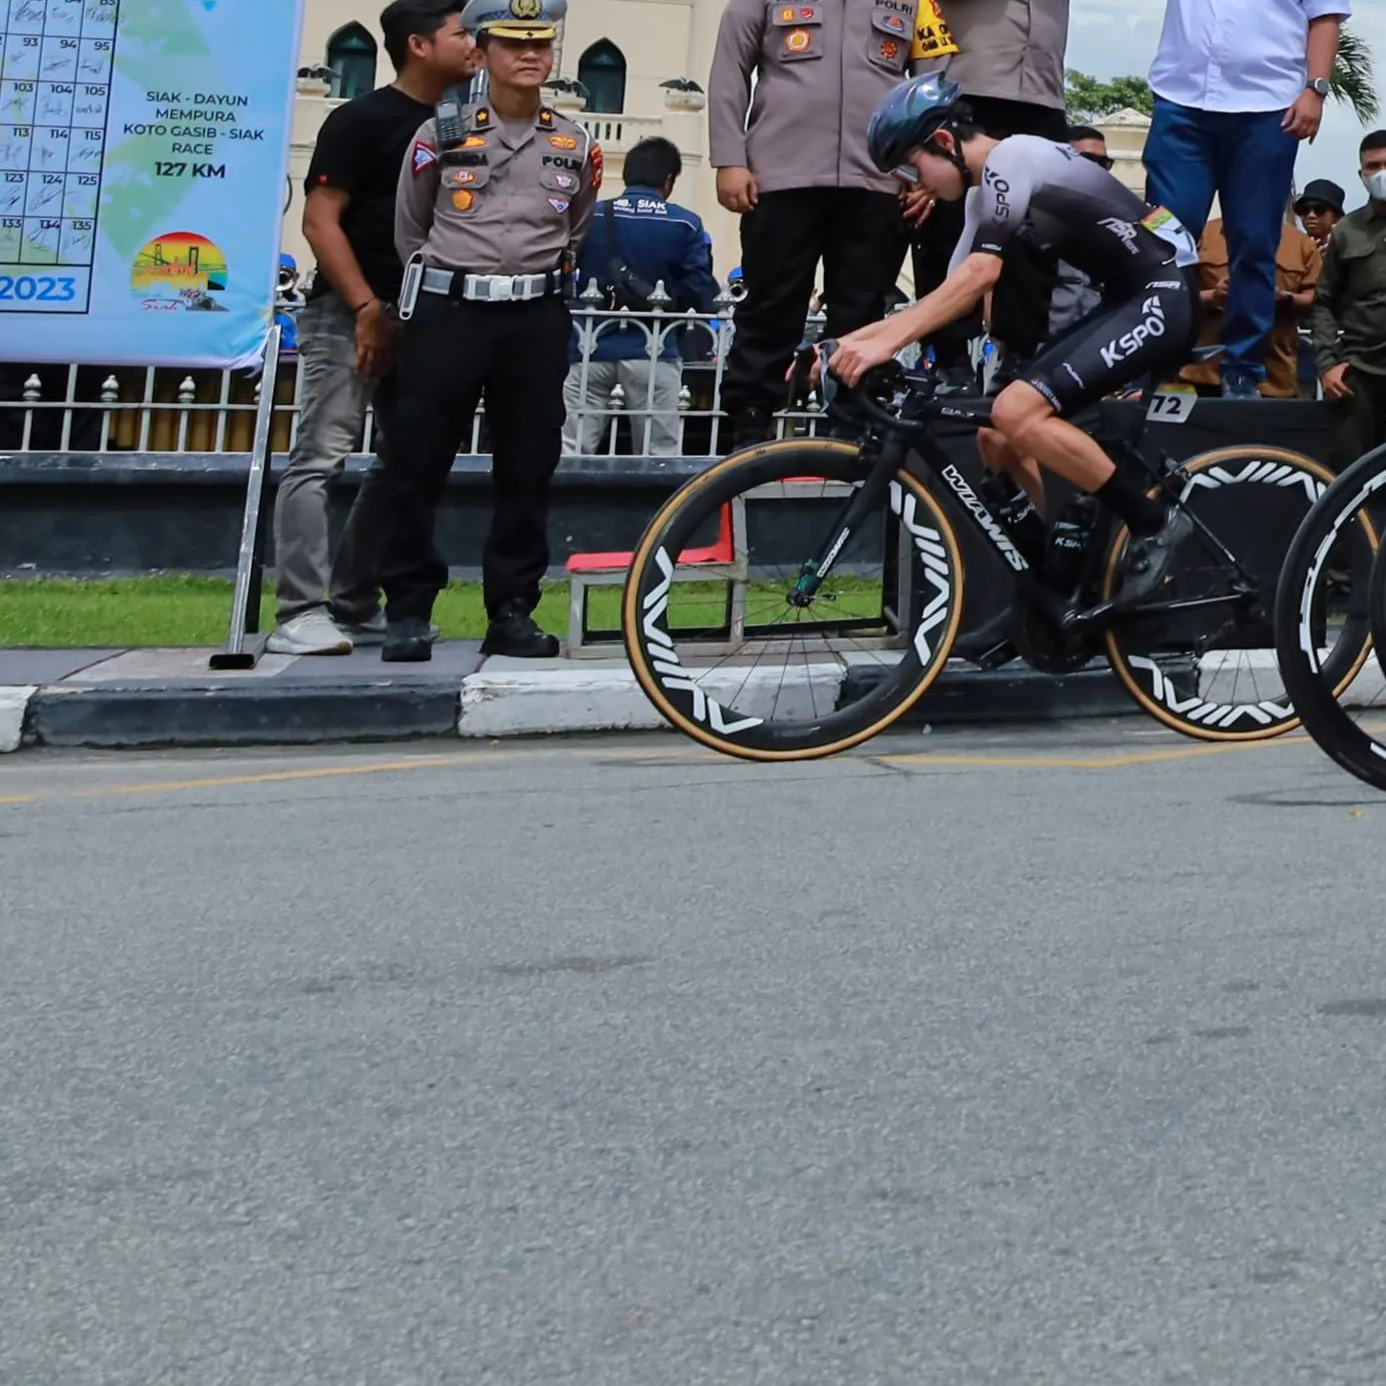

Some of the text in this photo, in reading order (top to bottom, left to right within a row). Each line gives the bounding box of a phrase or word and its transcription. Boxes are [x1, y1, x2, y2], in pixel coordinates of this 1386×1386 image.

[917, 27, 935, 41] KA
[23, 37, 110, 51] 93 94 95
[13, 82, 106, 96] 103 104 105
[146, 91, 182, 103] SIAK
[194, 93, 249, 106] DAYUN
[155, 108, 236, 123] MEMPURA
[13, 127, 101, 141] 113 114 115
[123, 124, 168, 136] KOTO
[170, 125, 217, 139] GASIB
[229, 128, 265, 141] SIAK
[172, 142, 213, 155] RACE
[154, 162, 226, 179] 127 KM
[5, 173, 97, 187] 123 124 125
[637, 199, 666, 210] SIAK
[1, 218, 93, 231] 133 134 135
[0, 276, 76, 301] 2023
[1099, 316, 1166, 369] KSPO
[1151, 395, 1182, 414] 72
[941, 464, 1030, 572] WIAWIS
